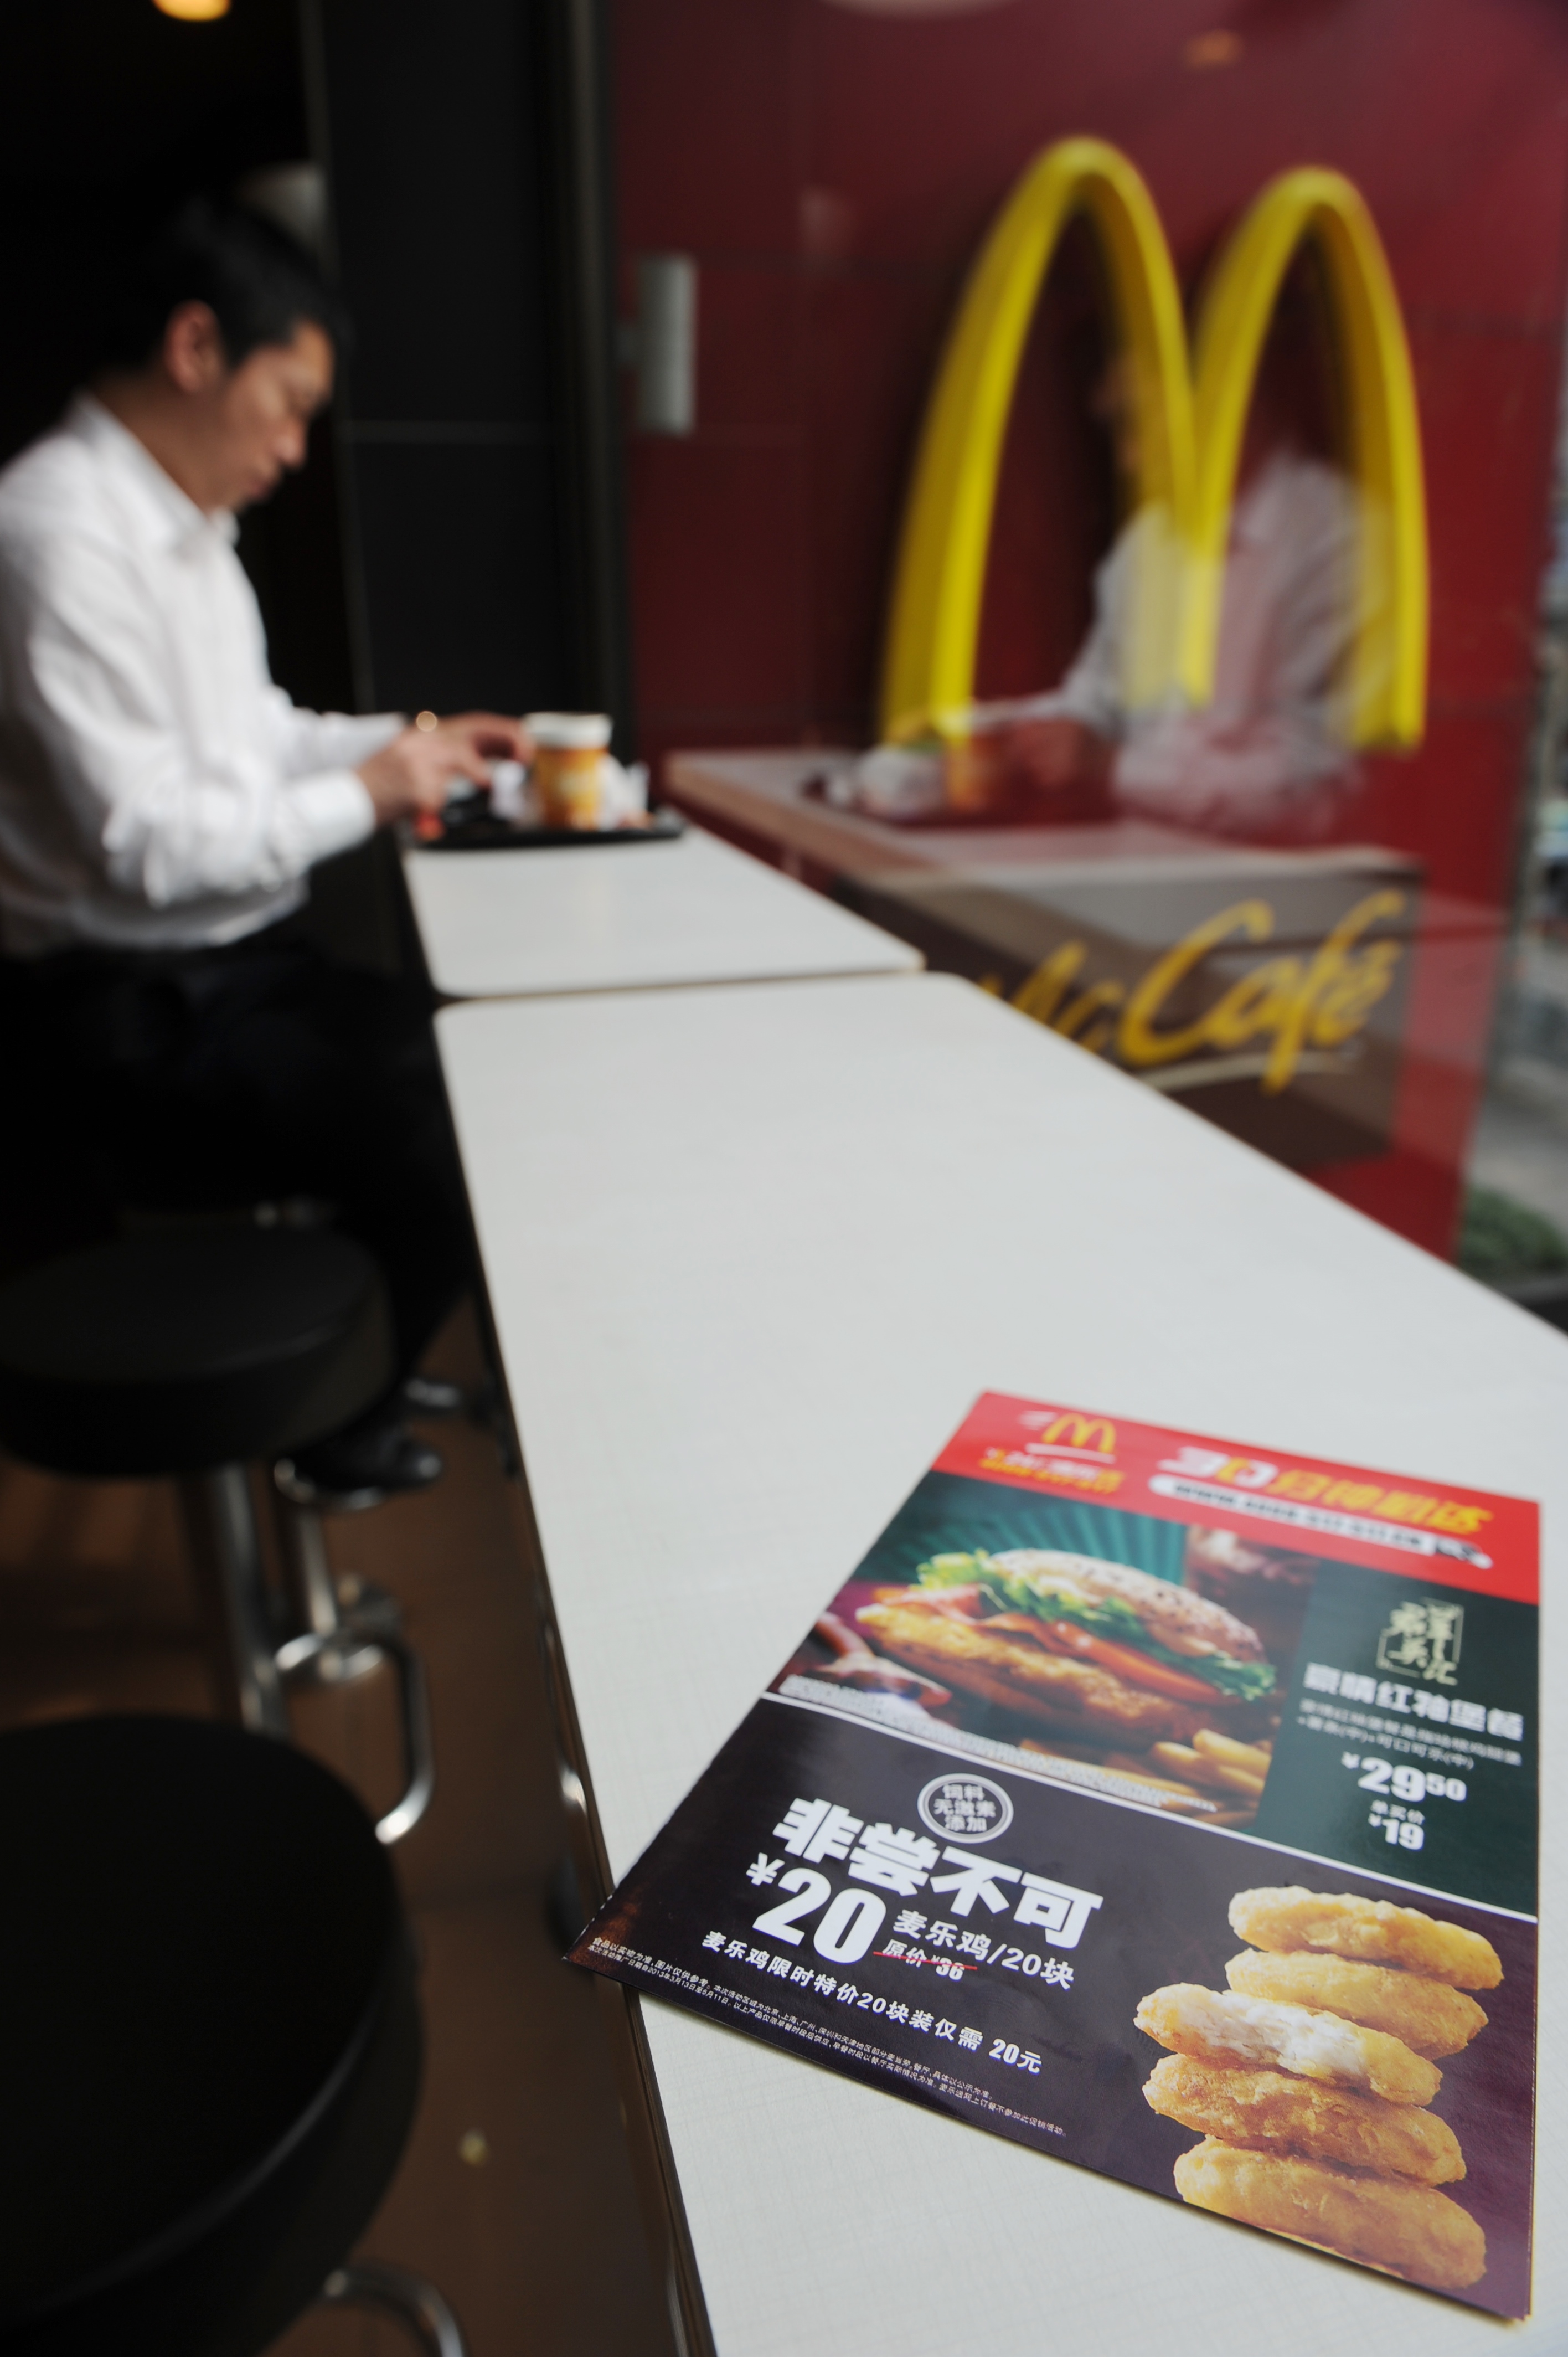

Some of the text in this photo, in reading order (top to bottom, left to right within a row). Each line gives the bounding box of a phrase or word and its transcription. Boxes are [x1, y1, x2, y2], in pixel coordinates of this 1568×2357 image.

[933, 1798, 997, 1818] 无激素
[942, 1784, 986, 1801] 饲料
[944, 1815, 987, 1833] 添加
[1368, 1813, 1425, 1851] ¥19
[772, 1798, 1103, 1949] 非尝不可
[746, 1852, 887, 1964] ¥20
[882, 1939, 928, 1968] 原价
[893, 1908, 1075, 1990] 麦乐鸡/20块
[702, 1930, 1043, 2075] 麦乐鸡限时特价20块装仅需 20元
